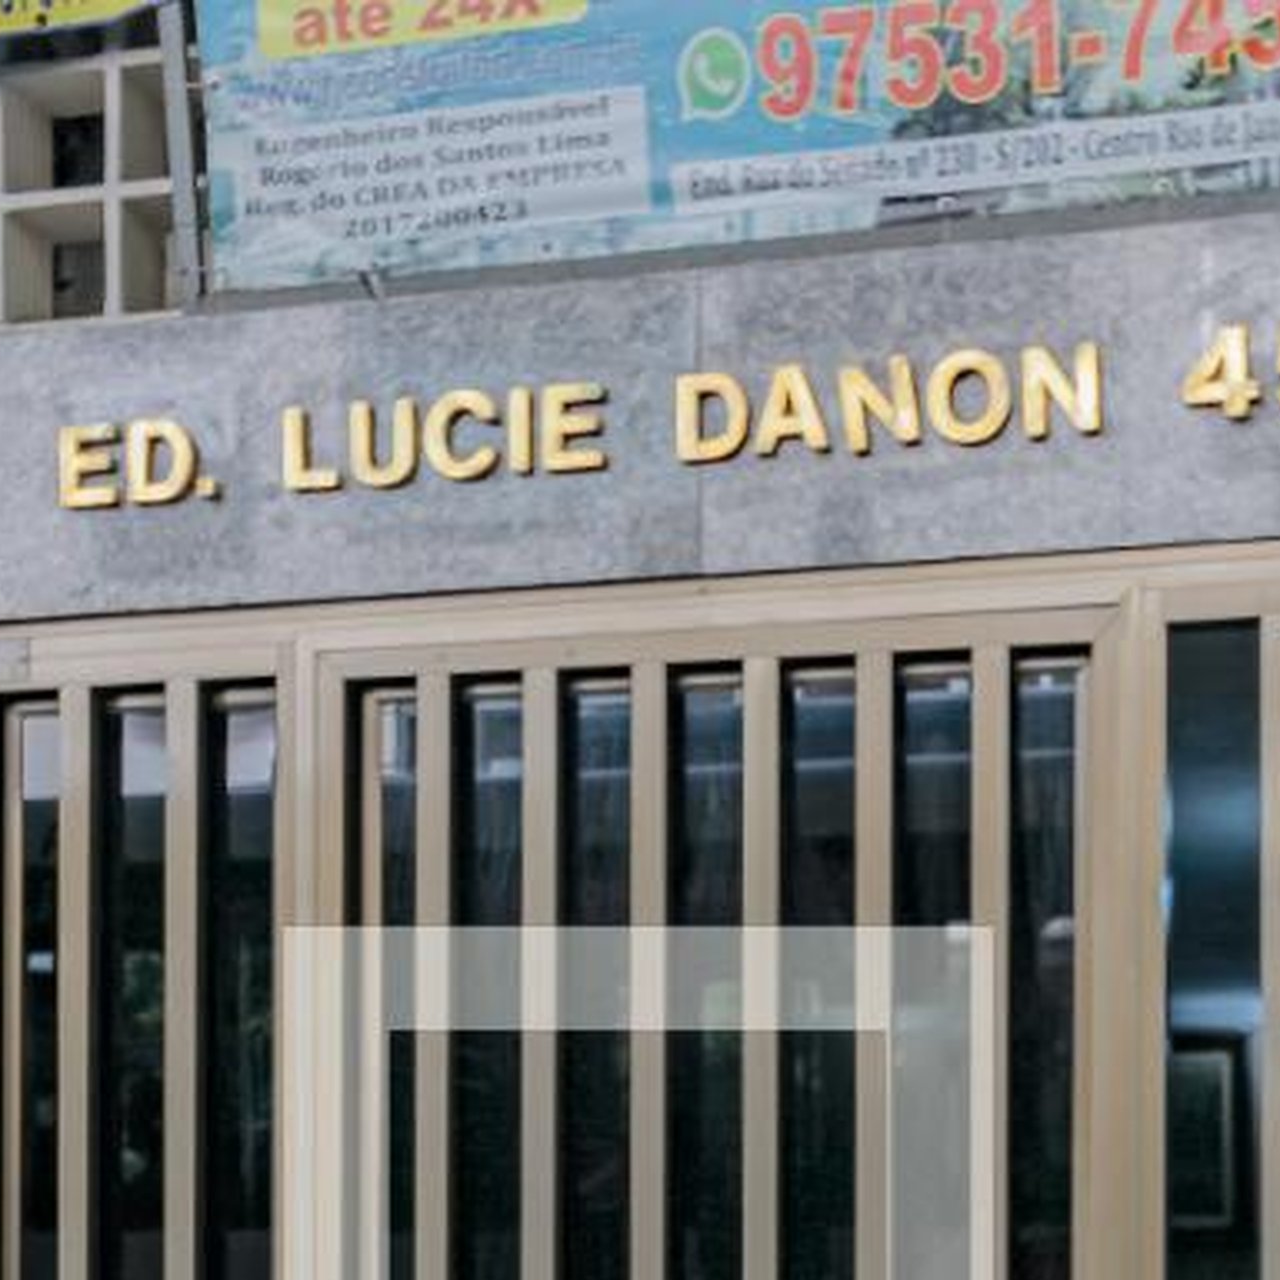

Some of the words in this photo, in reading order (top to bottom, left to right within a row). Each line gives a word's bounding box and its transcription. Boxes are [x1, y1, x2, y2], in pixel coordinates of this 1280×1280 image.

[58, 419, 220, 510] ED.
[281, 381, 608, 494] LUCIE
[674, 341, 1103, 465] DANON
